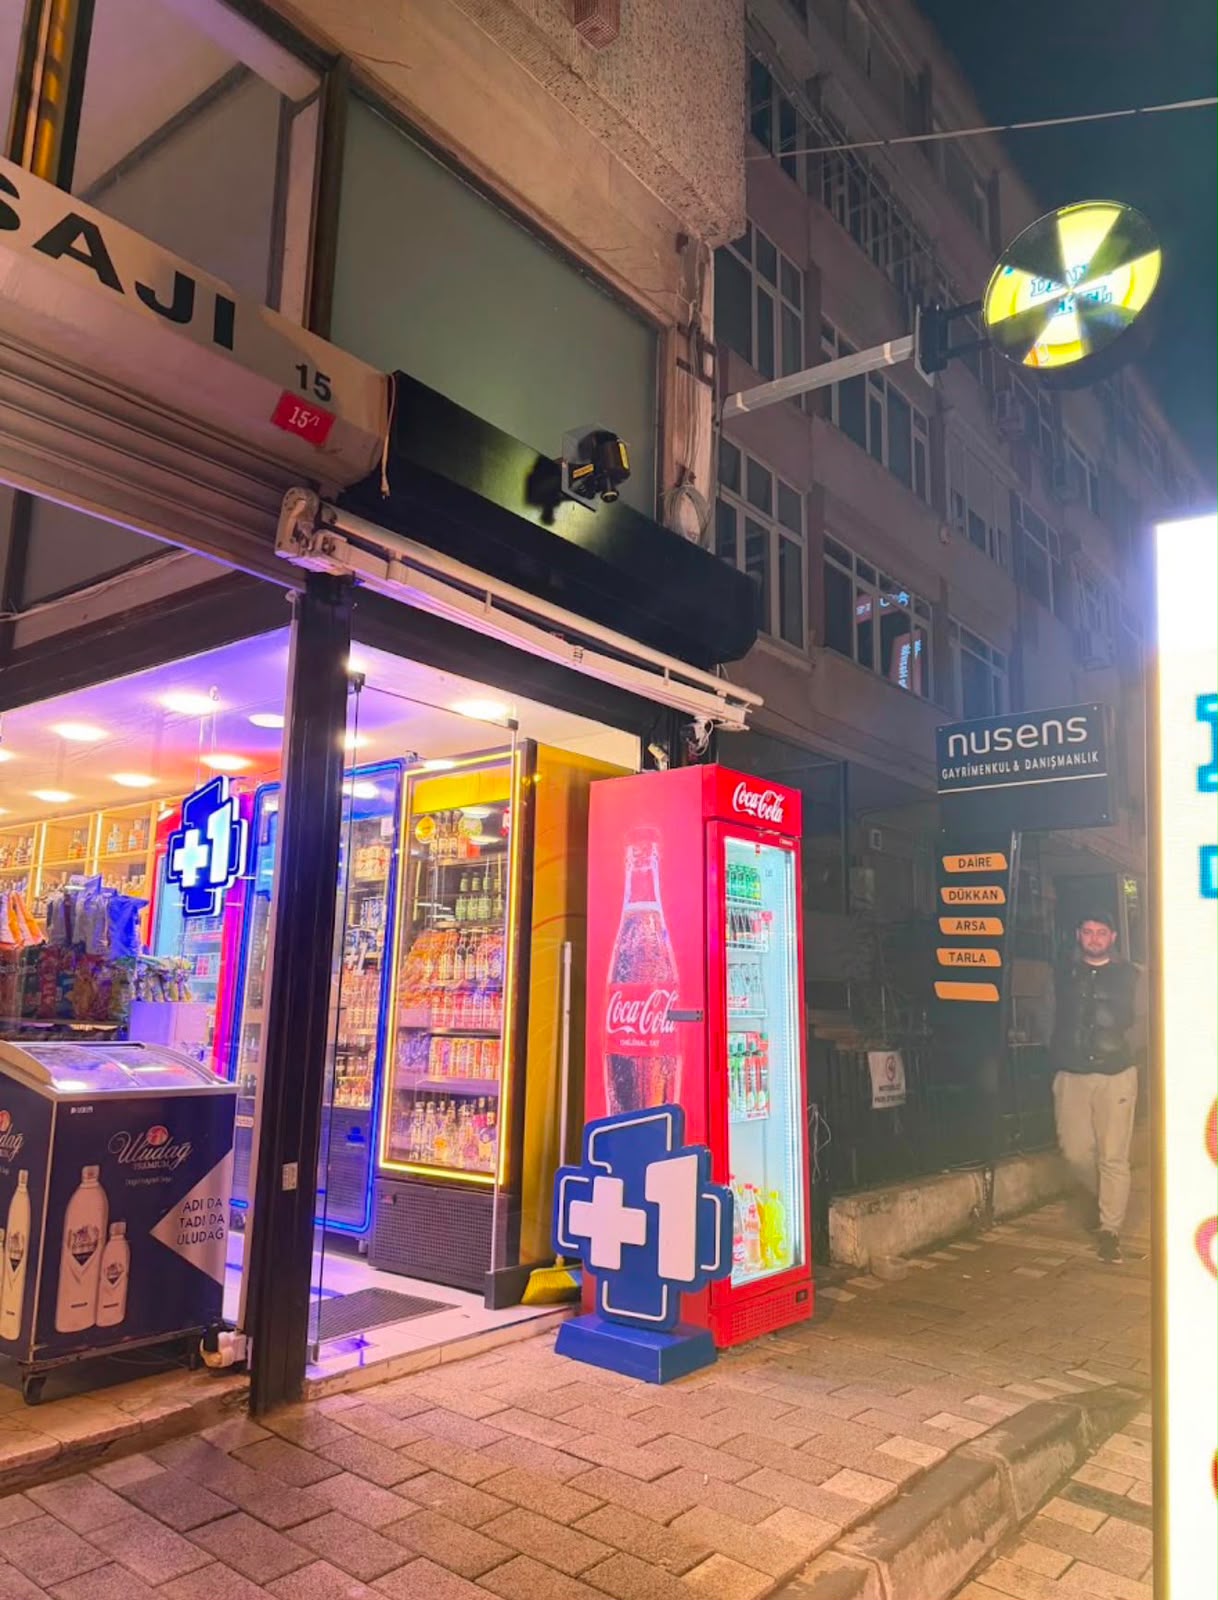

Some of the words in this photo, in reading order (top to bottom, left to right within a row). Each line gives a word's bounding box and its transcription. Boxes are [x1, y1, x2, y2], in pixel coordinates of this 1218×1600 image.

[295, 363, 332, 402] 15
[948, 716, 1088, 758] nusens
[941, 761, 1011, 780] GAYRİMENKUL
[1013, 763, 1020, 772] &
[1024, 751, 1099, 770] DANIŞMANLIK
[732, 781, 785, 824] Coca-Cola
[958, 856, 993, 869] DAİRE
[948, 888, 998, 901] DÜKKAN
[955, 920, 987, 931] ARSA
[948, 951, 987, 963] TARLA
[107, 1130, 193, 1171] Uludağ
[182, 1200, 204, 1213] ADI
[206, 1198, 223, 1210] DA
[179, 1216, 206, 1229] TADI
[209, 1214, 225, 1225] DA
[176, 1228, 225, 1246] ULUDAĞ
